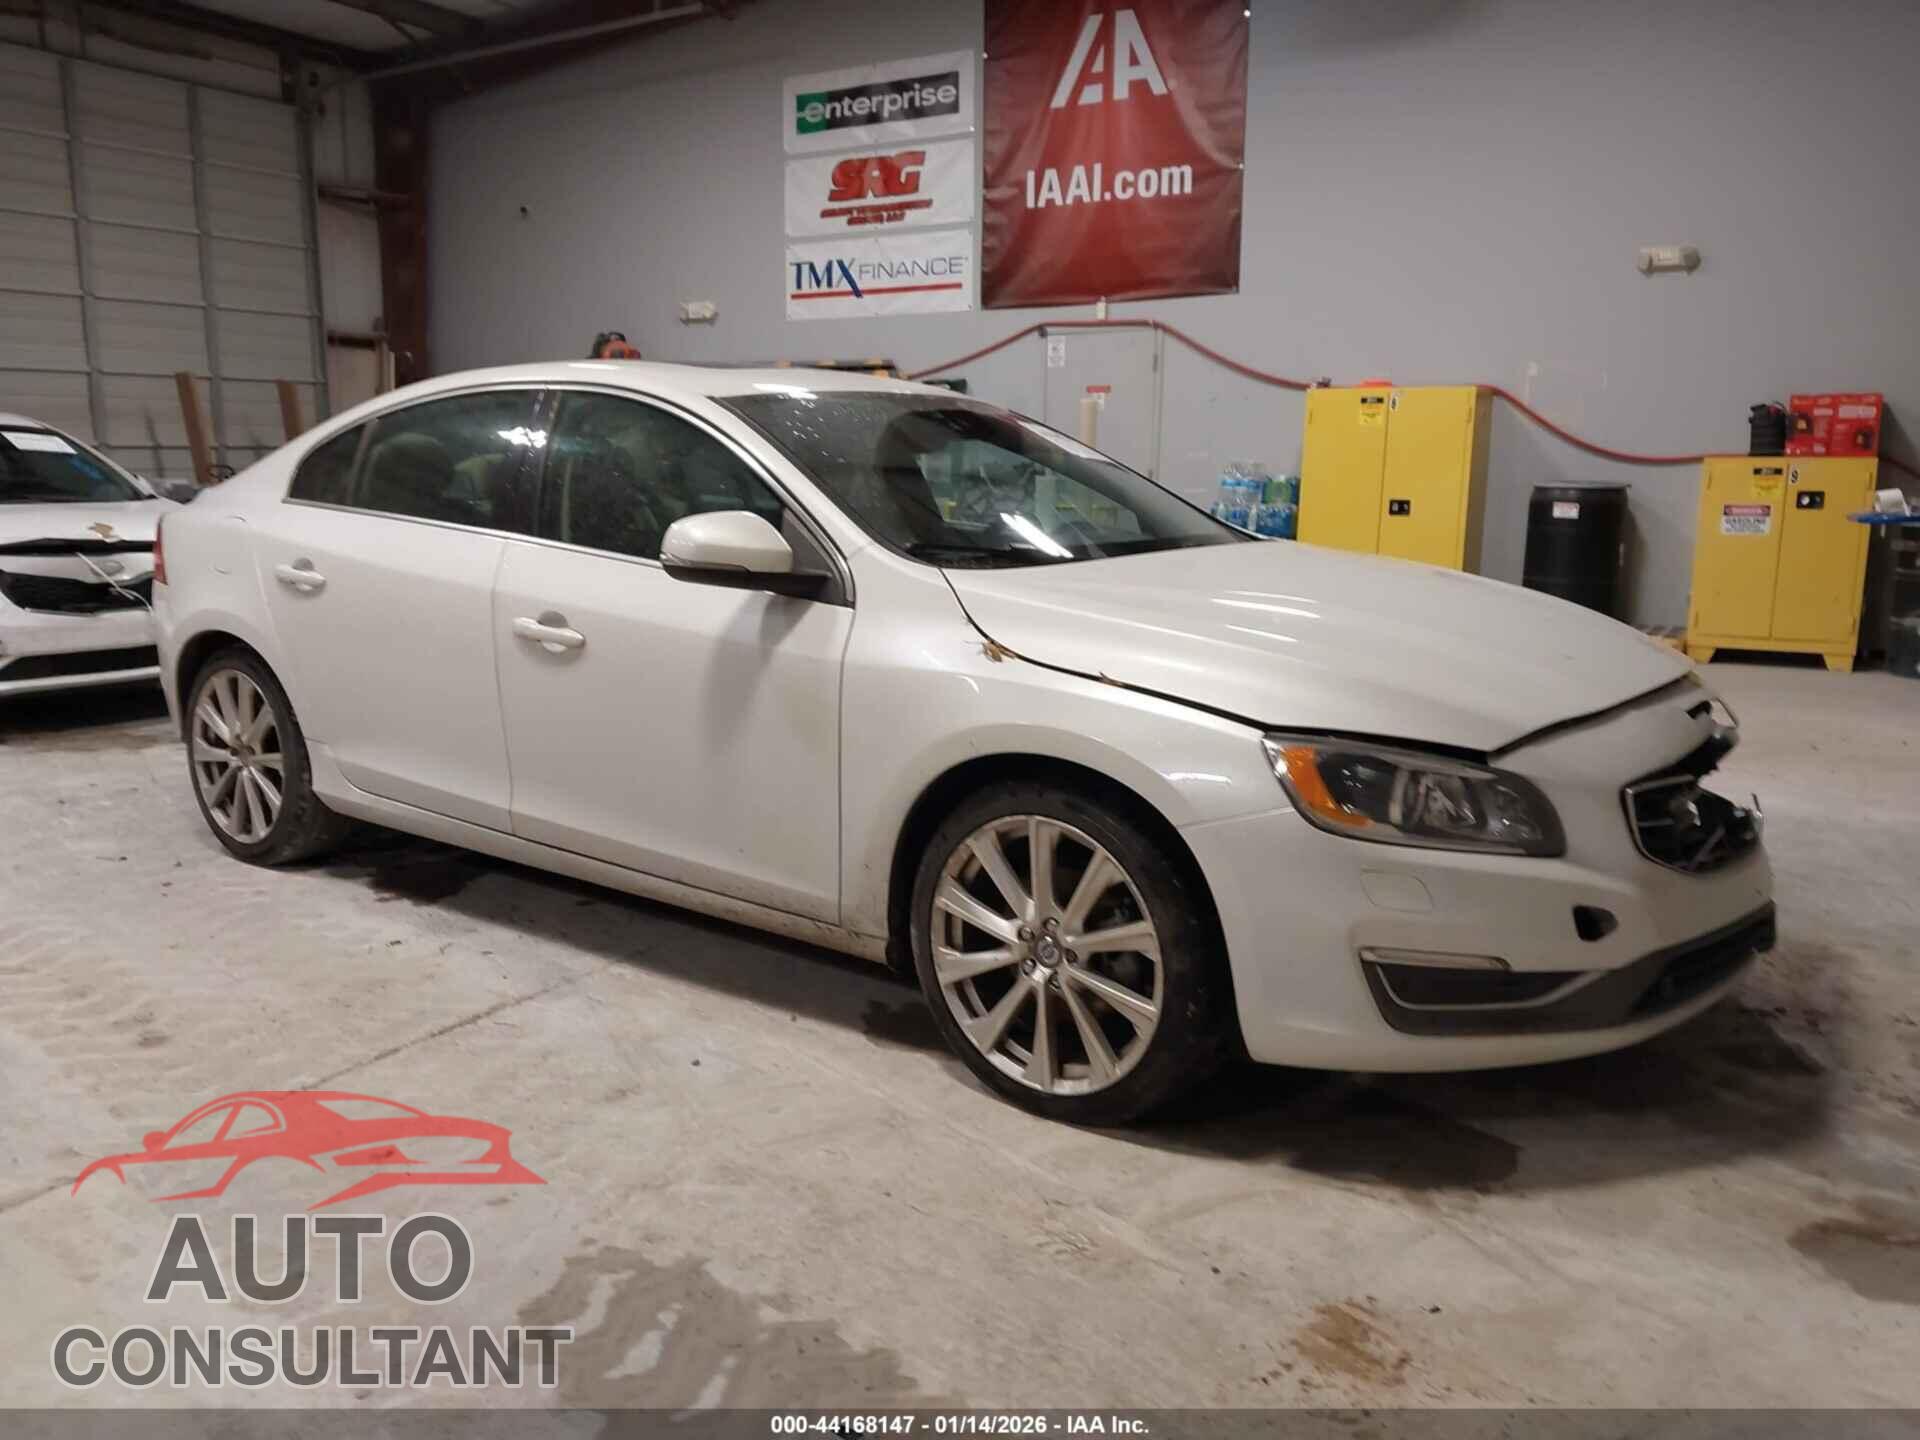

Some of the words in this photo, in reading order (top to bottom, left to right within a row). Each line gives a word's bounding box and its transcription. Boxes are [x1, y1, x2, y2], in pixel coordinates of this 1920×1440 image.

[803, 83, 958, 123] enterprise
[1025, 162, 1193, 209] IAAI.com
[790, 257, 863, 298] TMX
